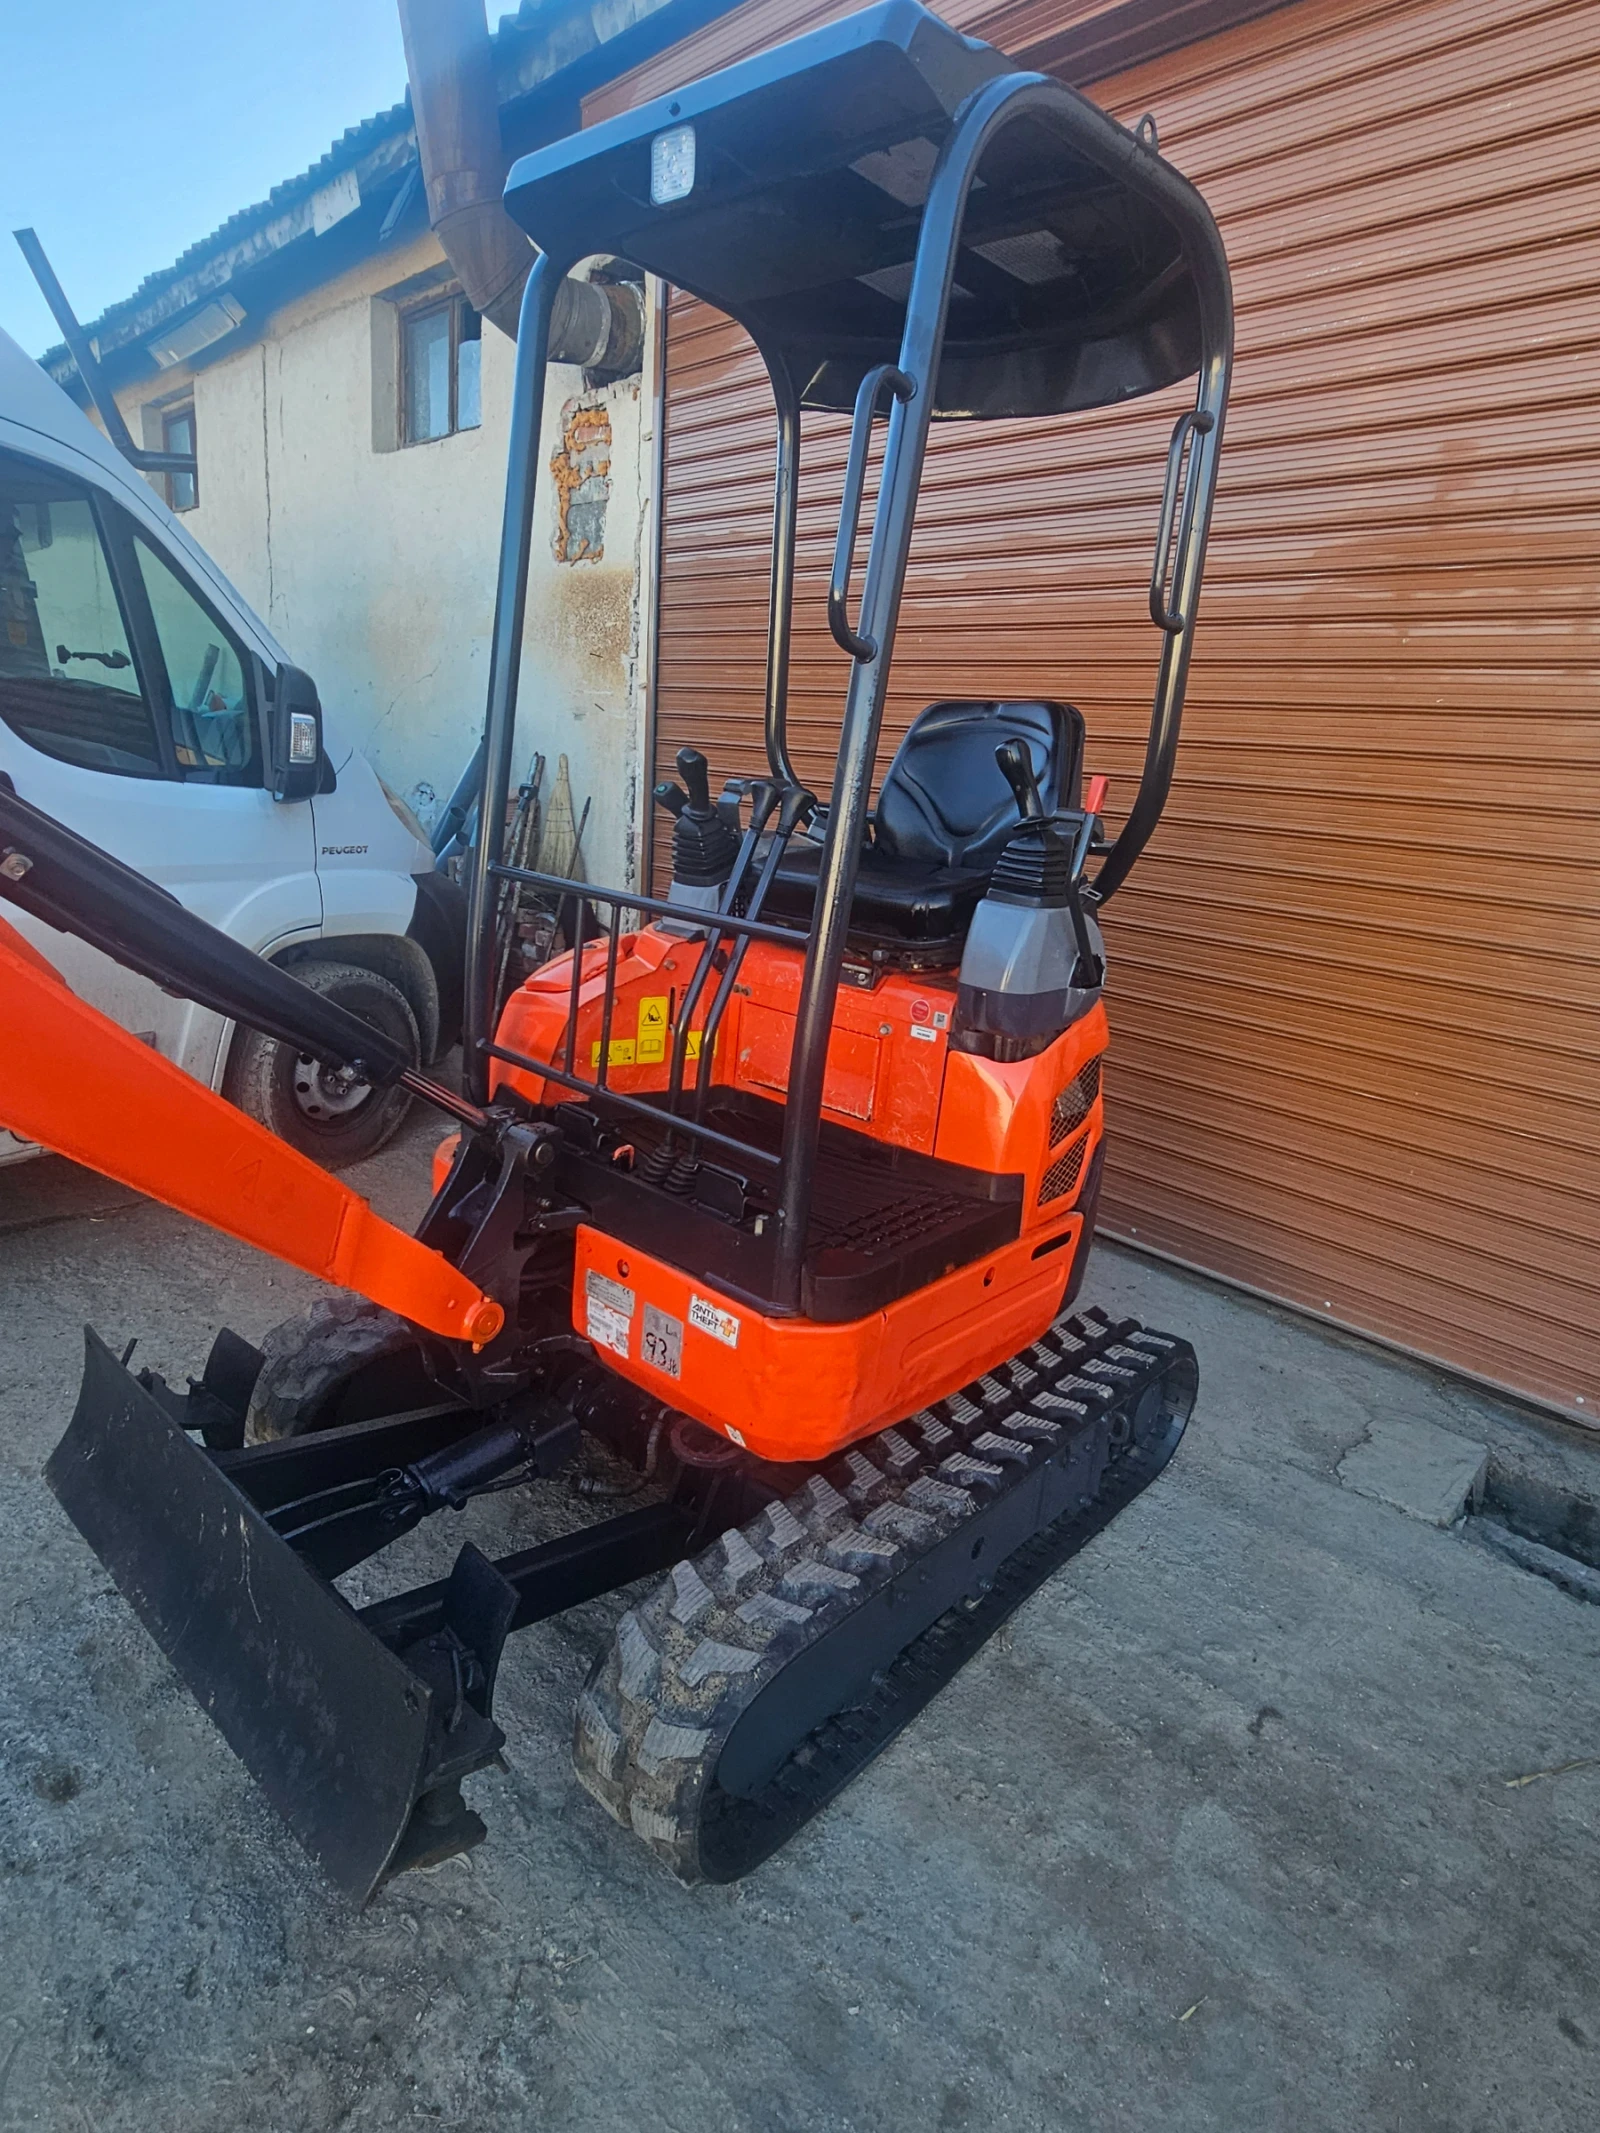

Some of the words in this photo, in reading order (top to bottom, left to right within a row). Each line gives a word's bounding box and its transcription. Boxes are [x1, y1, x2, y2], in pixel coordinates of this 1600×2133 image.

[321, 845, 369, 855] PEUGEOT
[691, 1309, 719, 1330] THEFT
[692, 1303, 714, 1319] ANTI
[645, 1332, 667, 1366] 93
